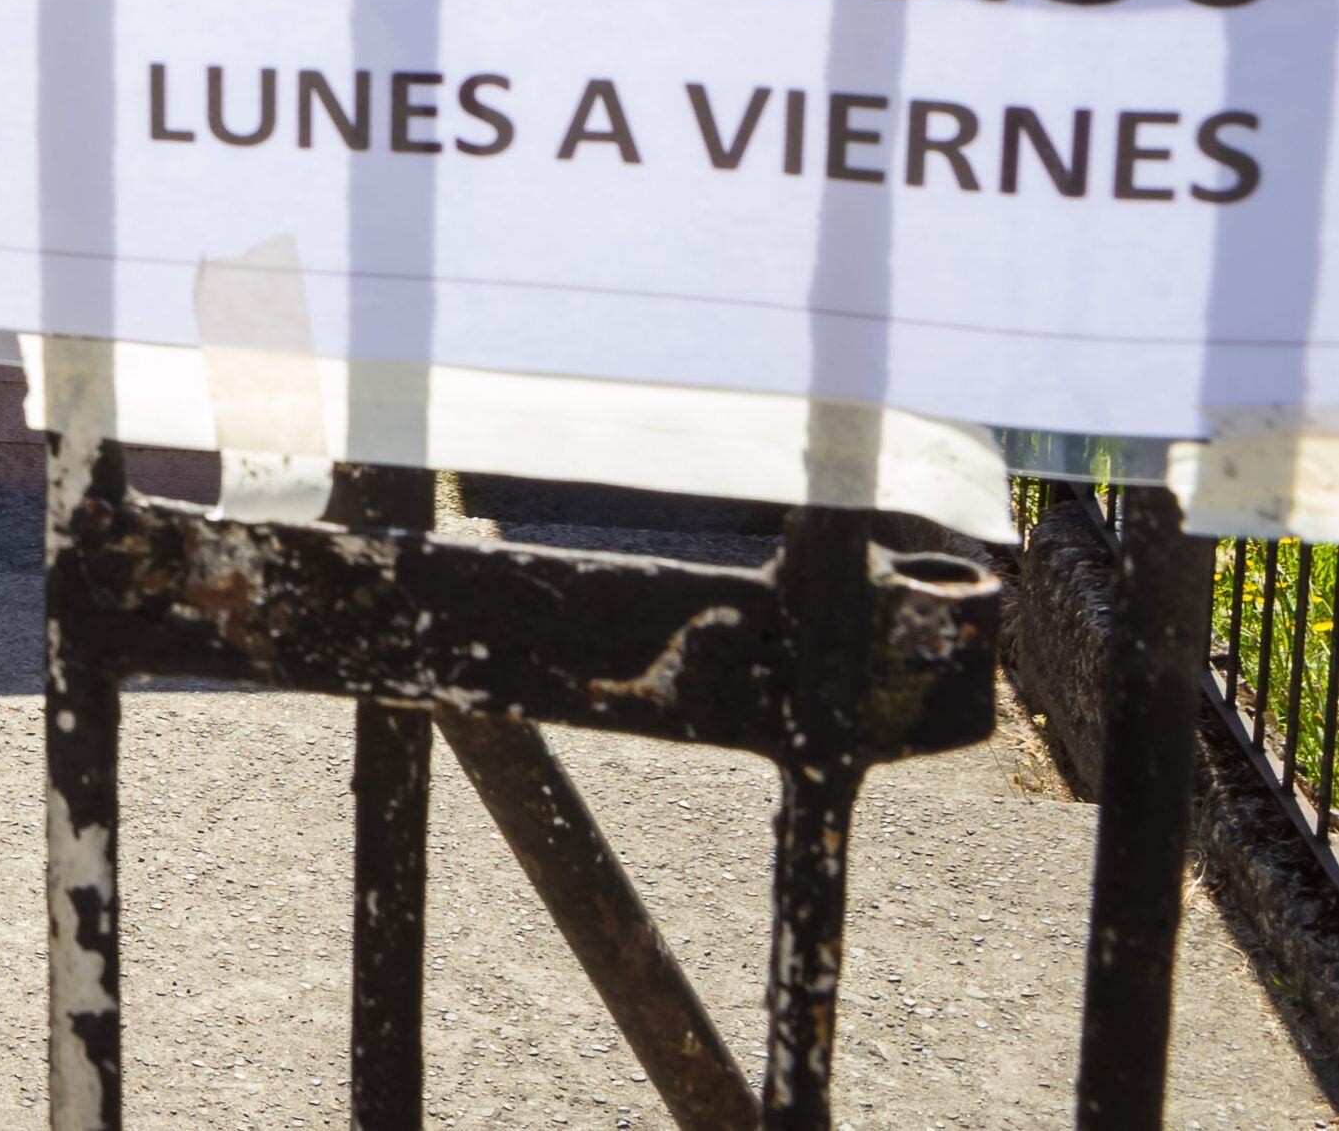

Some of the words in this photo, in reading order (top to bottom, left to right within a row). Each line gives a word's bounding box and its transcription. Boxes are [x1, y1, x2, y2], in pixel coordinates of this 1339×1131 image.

[148, 62, 516, 158] LUNES
[556, 78, 642, 165] A
[684, 82, 1265, 207] VIERNES
